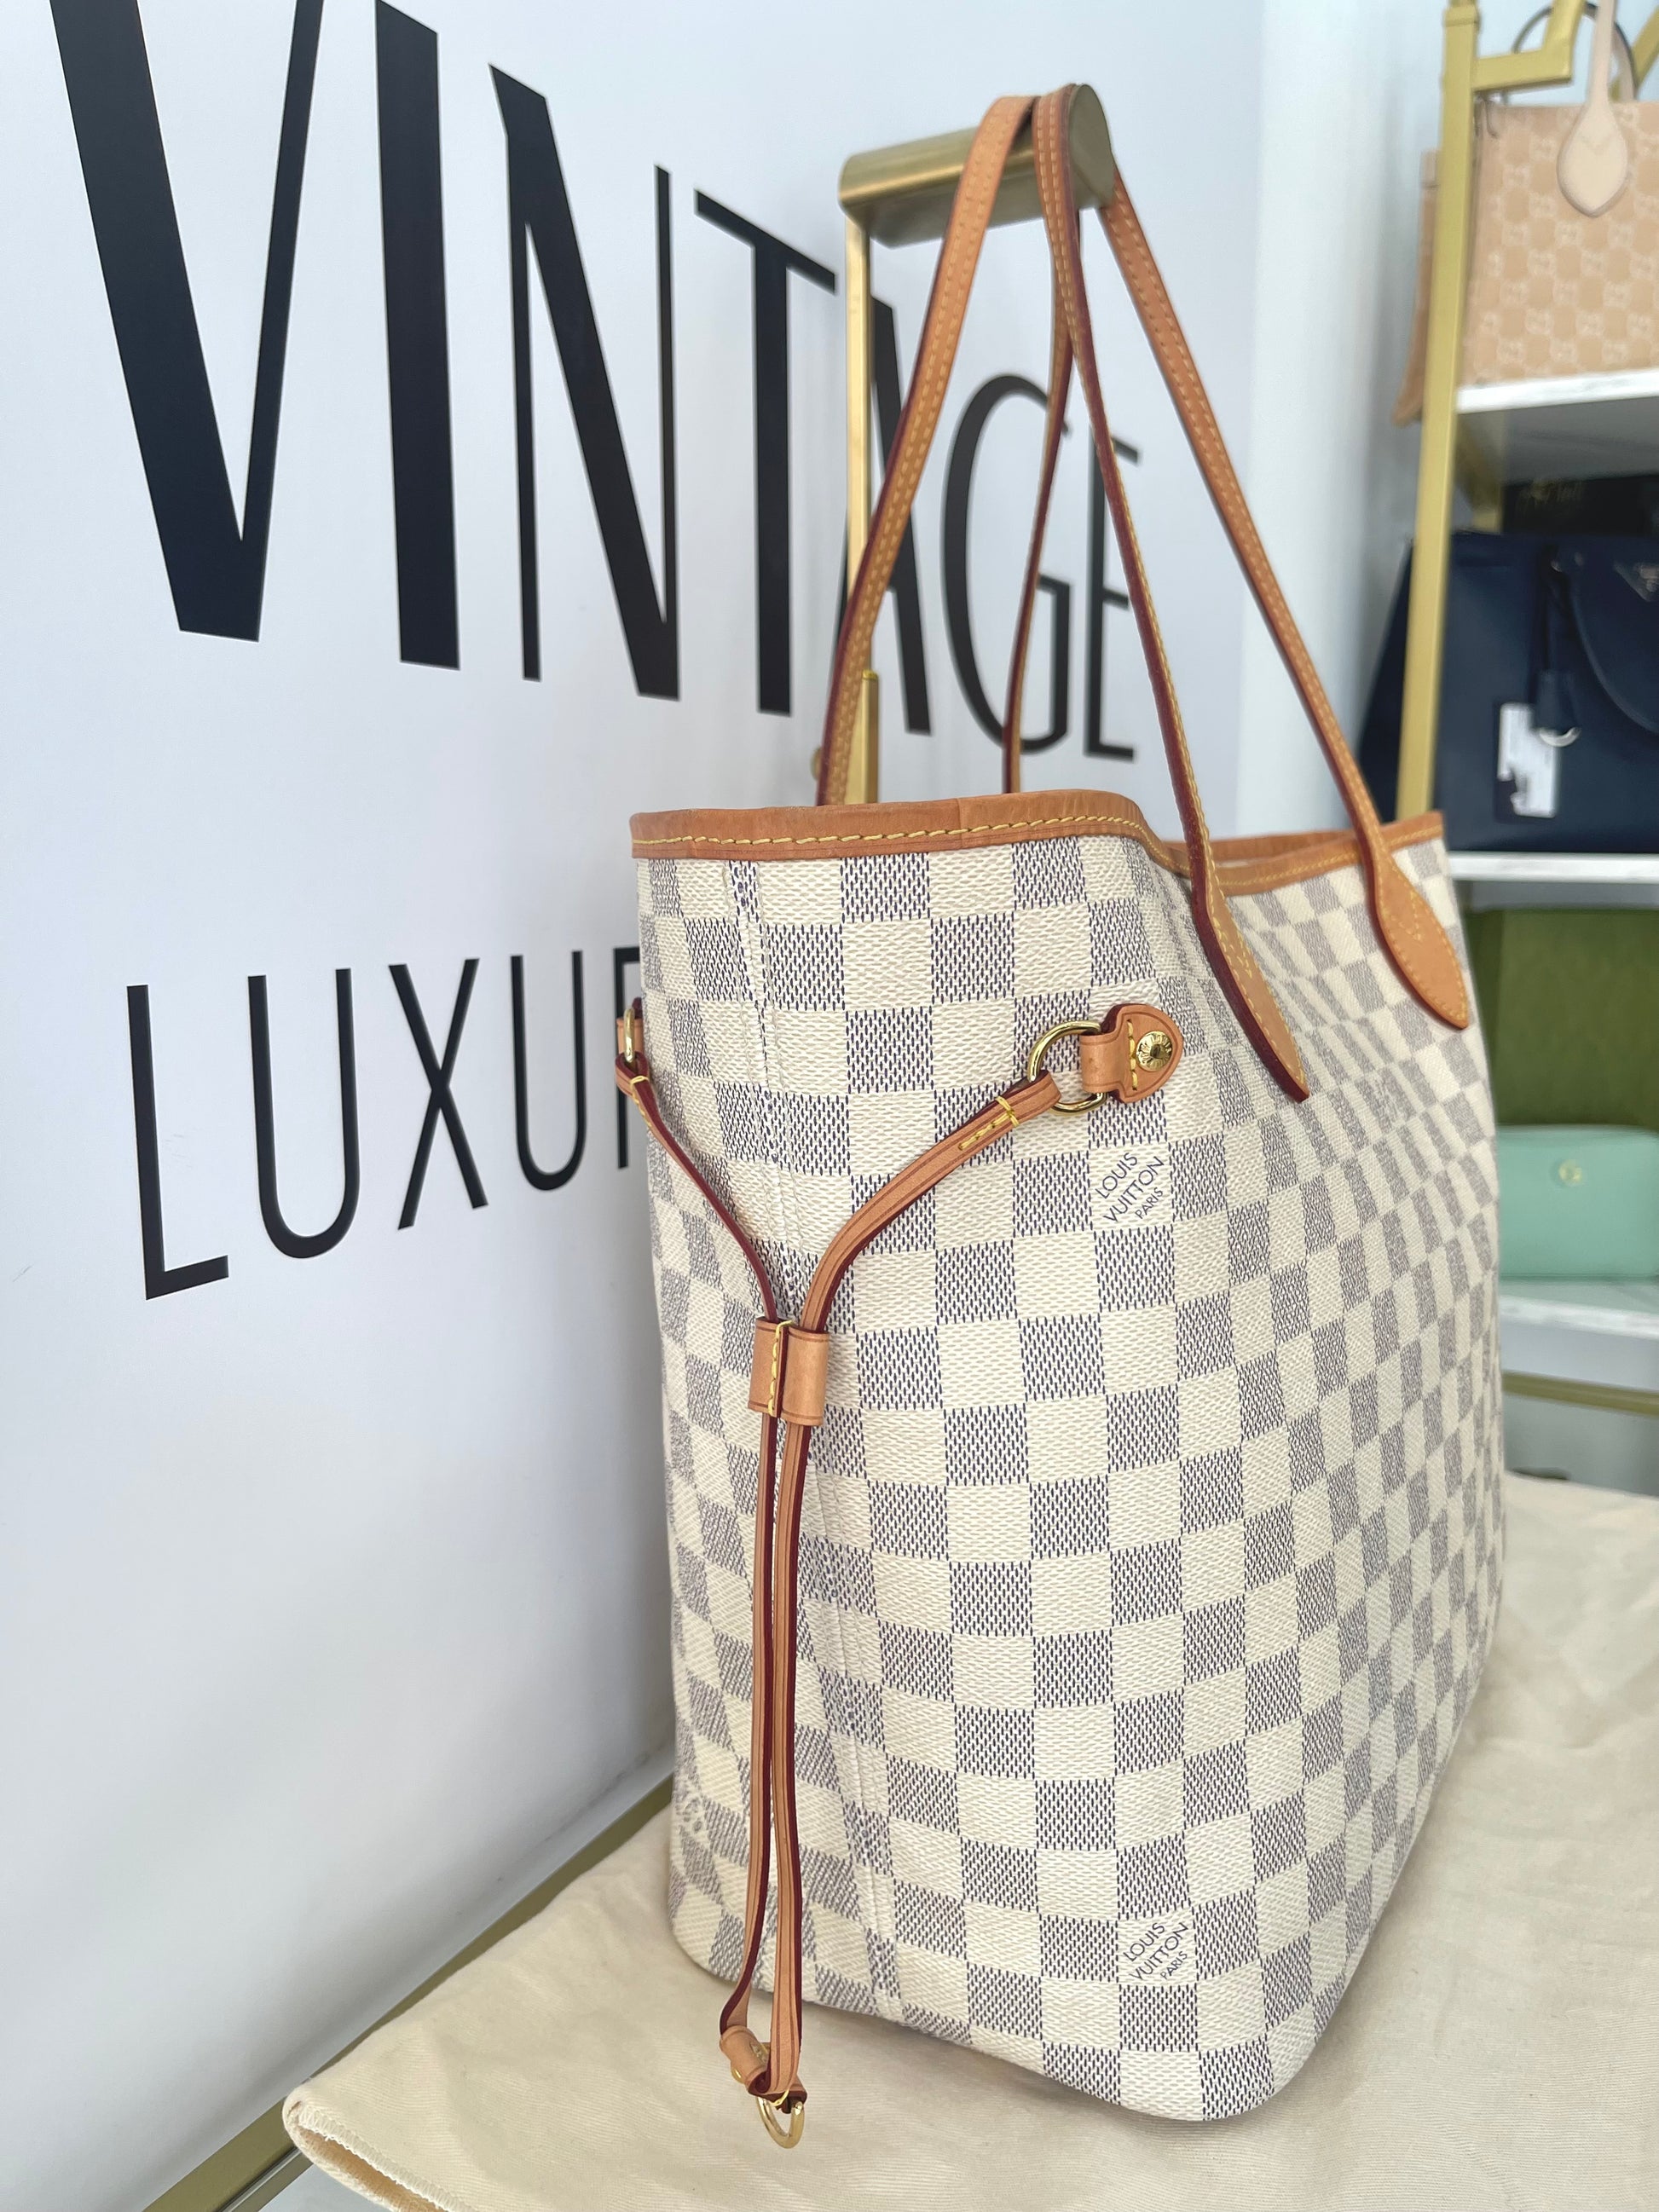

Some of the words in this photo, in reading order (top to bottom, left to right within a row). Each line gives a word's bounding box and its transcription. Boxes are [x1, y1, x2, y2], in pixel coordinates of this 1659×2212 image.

[1095, 1152, 1138, 1198] LOUIS
[1102, 1156, 1165, 1222] VUITTON
[1135, 1187, 1163, 1220] PARIS
[1123, 1922, 1165, 1961] LOUIS
[1129, 1922, 1188, 1980] VUITTON
[1160, 1950, 1188, 1979] PARIS
